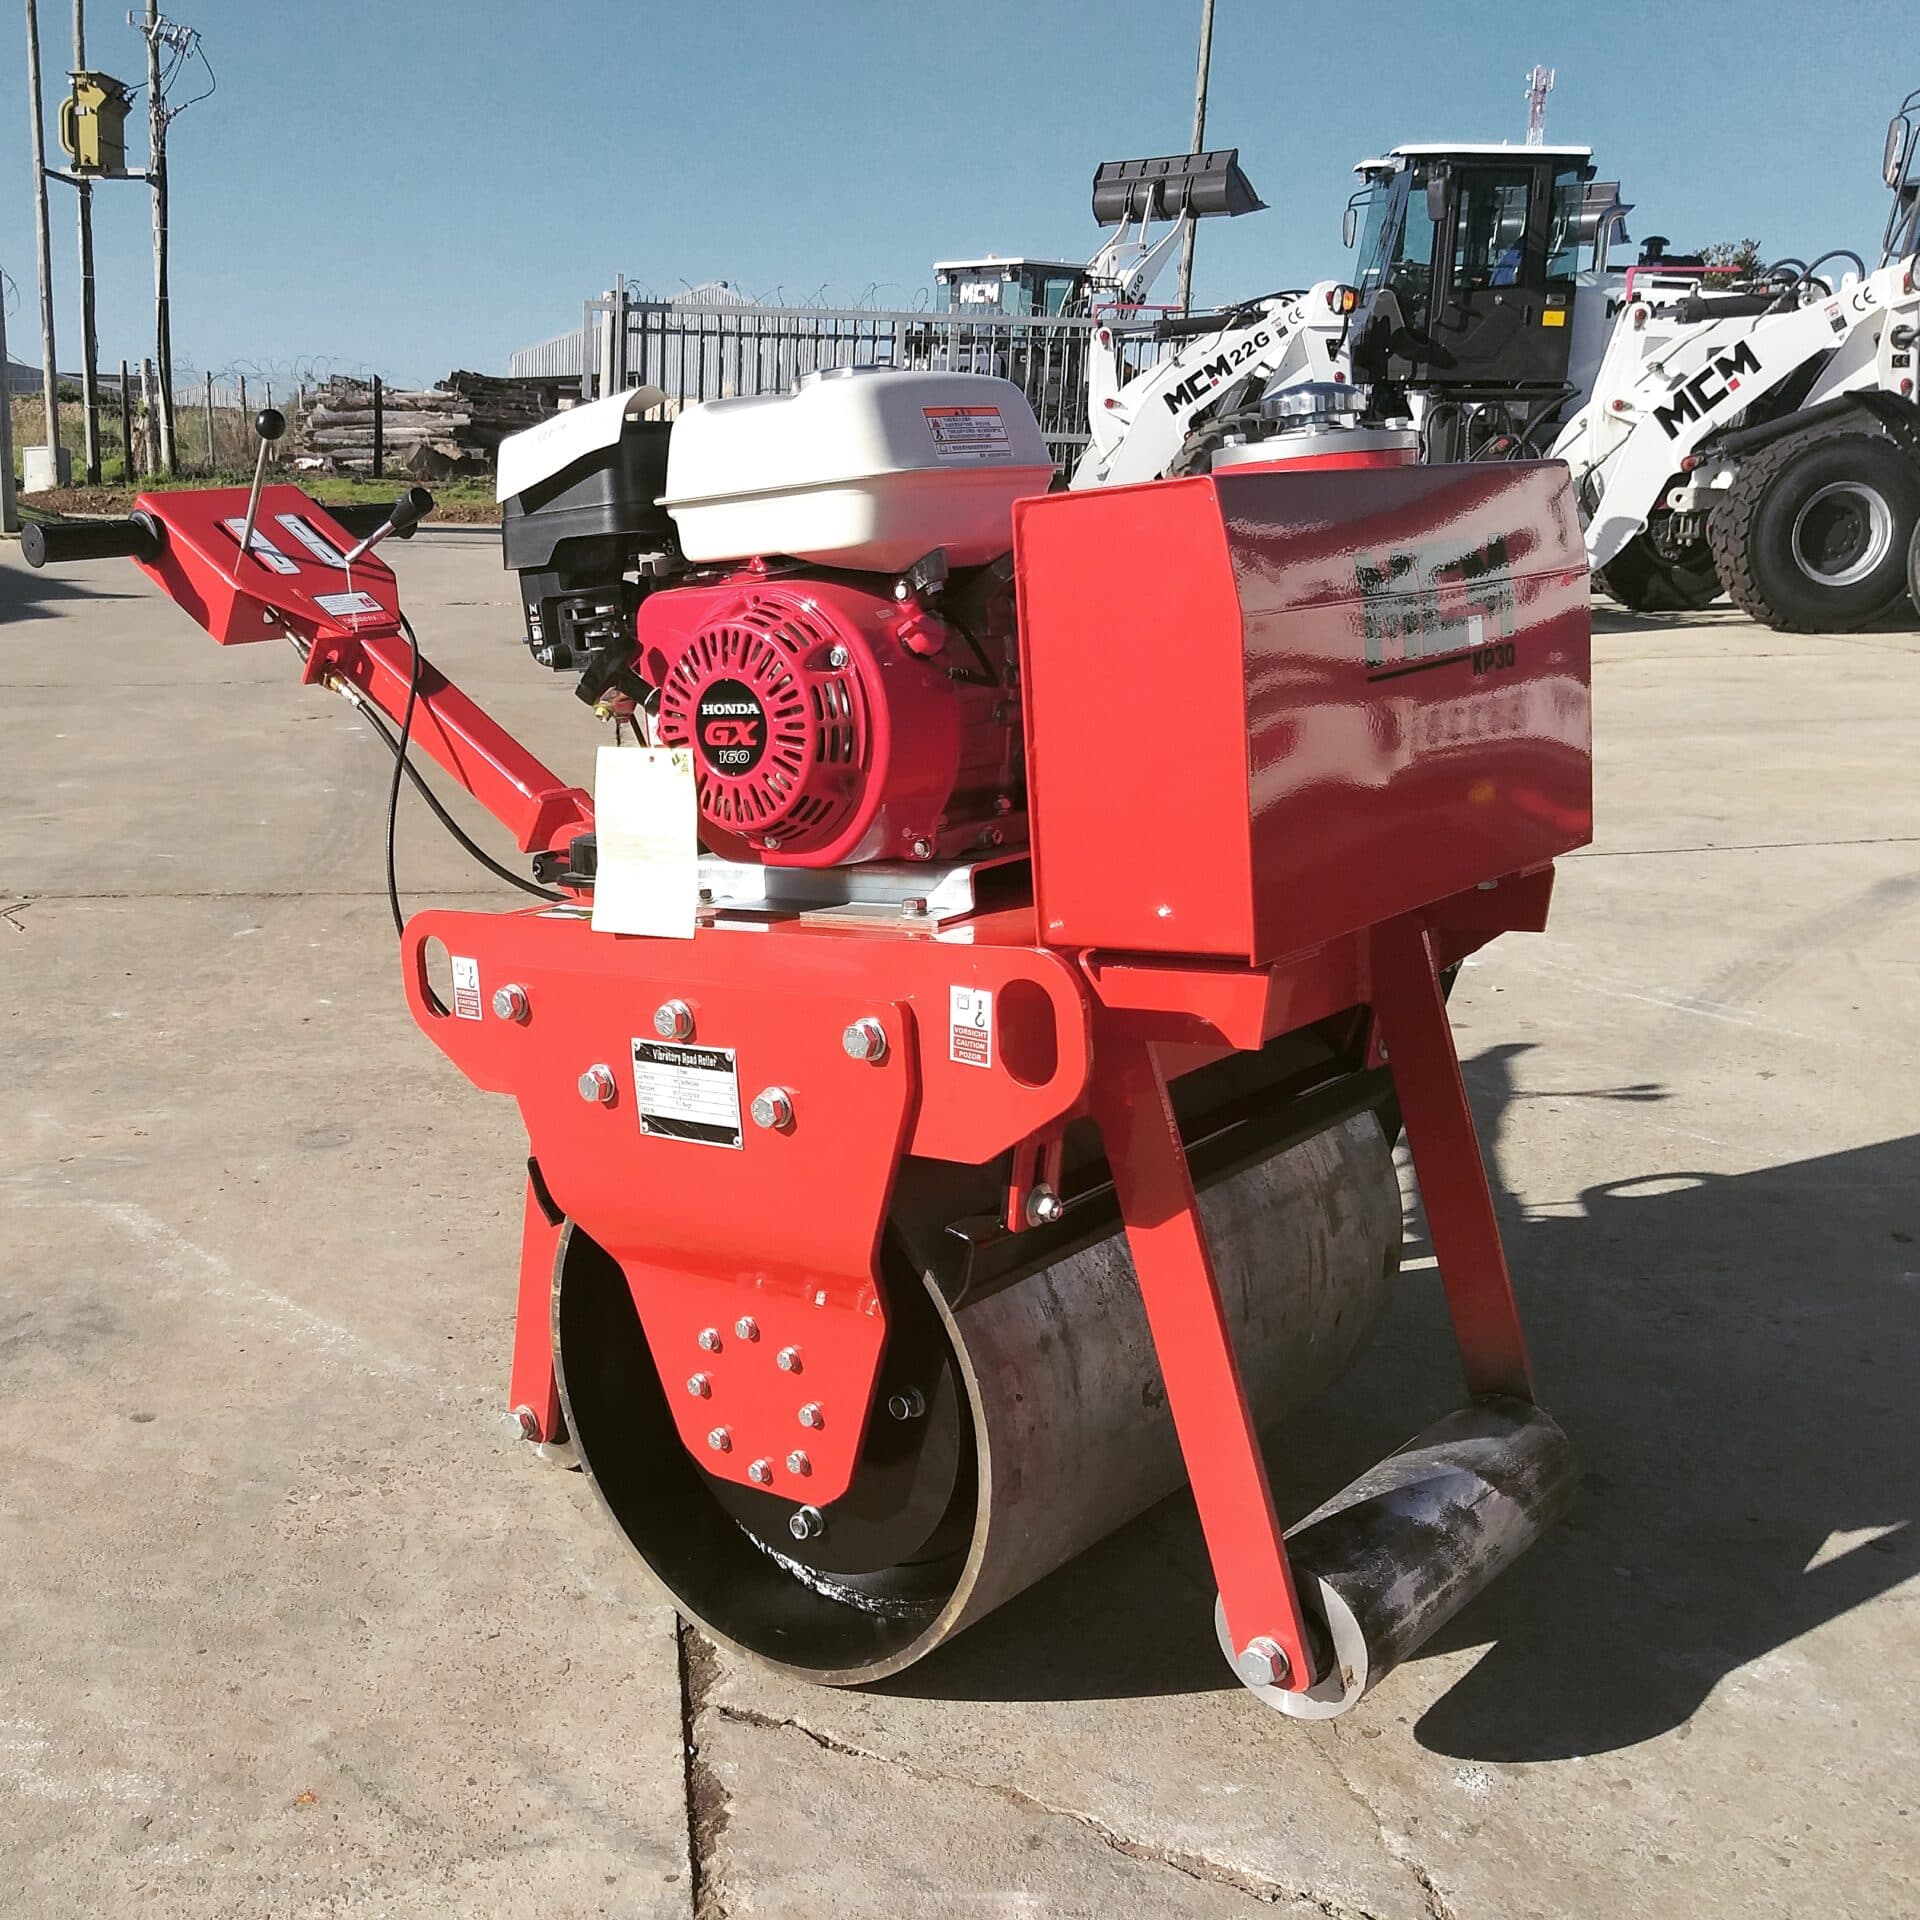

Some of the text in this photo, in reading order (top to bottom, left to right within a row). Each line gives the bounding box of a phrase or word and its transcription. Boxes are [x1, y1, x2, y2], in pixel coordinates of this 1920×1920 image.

[1163, 330, 1270, 415] MCM 22G
[1652, 340, 1762, 441] MCM
[1472, 643, 1515, 676] KP30
[701, 703, 760, 715] HONDA
[704, 720, 758, 746] GX
[718, 750, 750, 764] 160
[955, 1038, 985, 1051] CAUTION
[958, 1050, 982, 1061] POZOR
